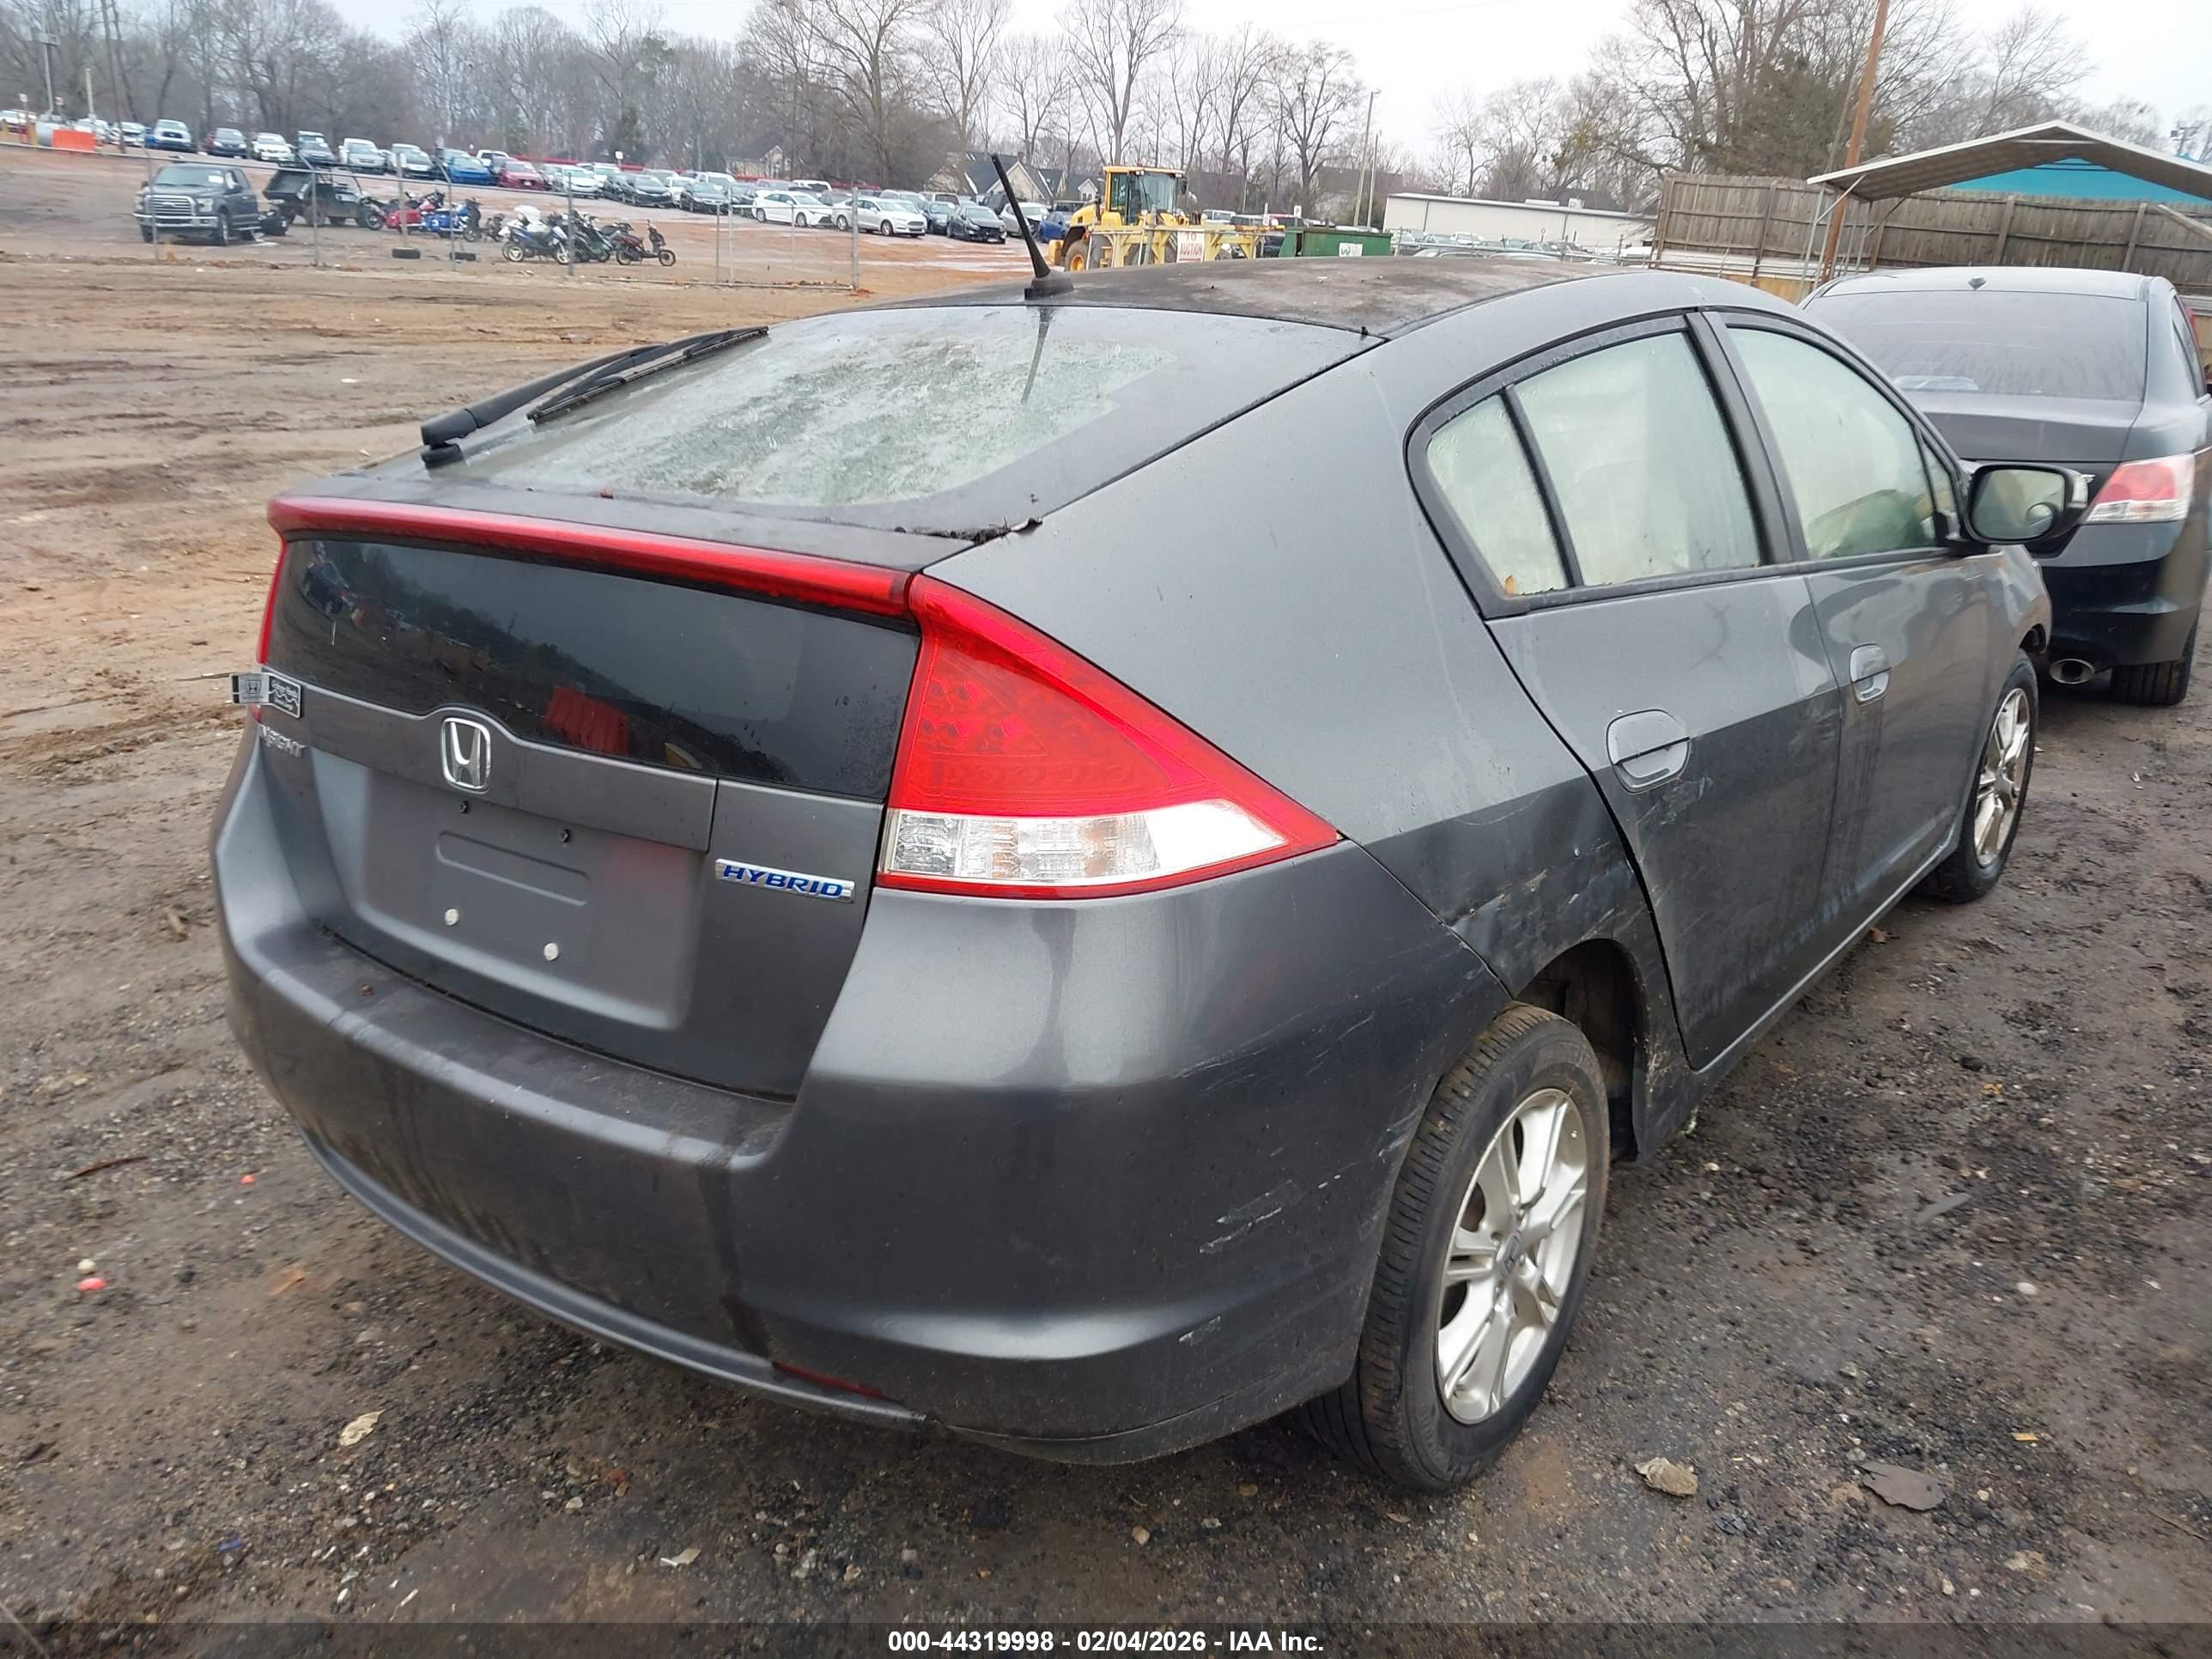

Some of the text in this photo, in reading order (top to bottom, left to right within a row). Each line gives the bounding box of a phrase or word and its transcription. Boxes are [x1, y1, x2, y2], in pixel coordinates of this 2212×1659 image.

[1186, 232, 1197, 241] TO
[1180, 242, 1203, 256] AUCTION
[722, 864, 845, 897] HYBRID
